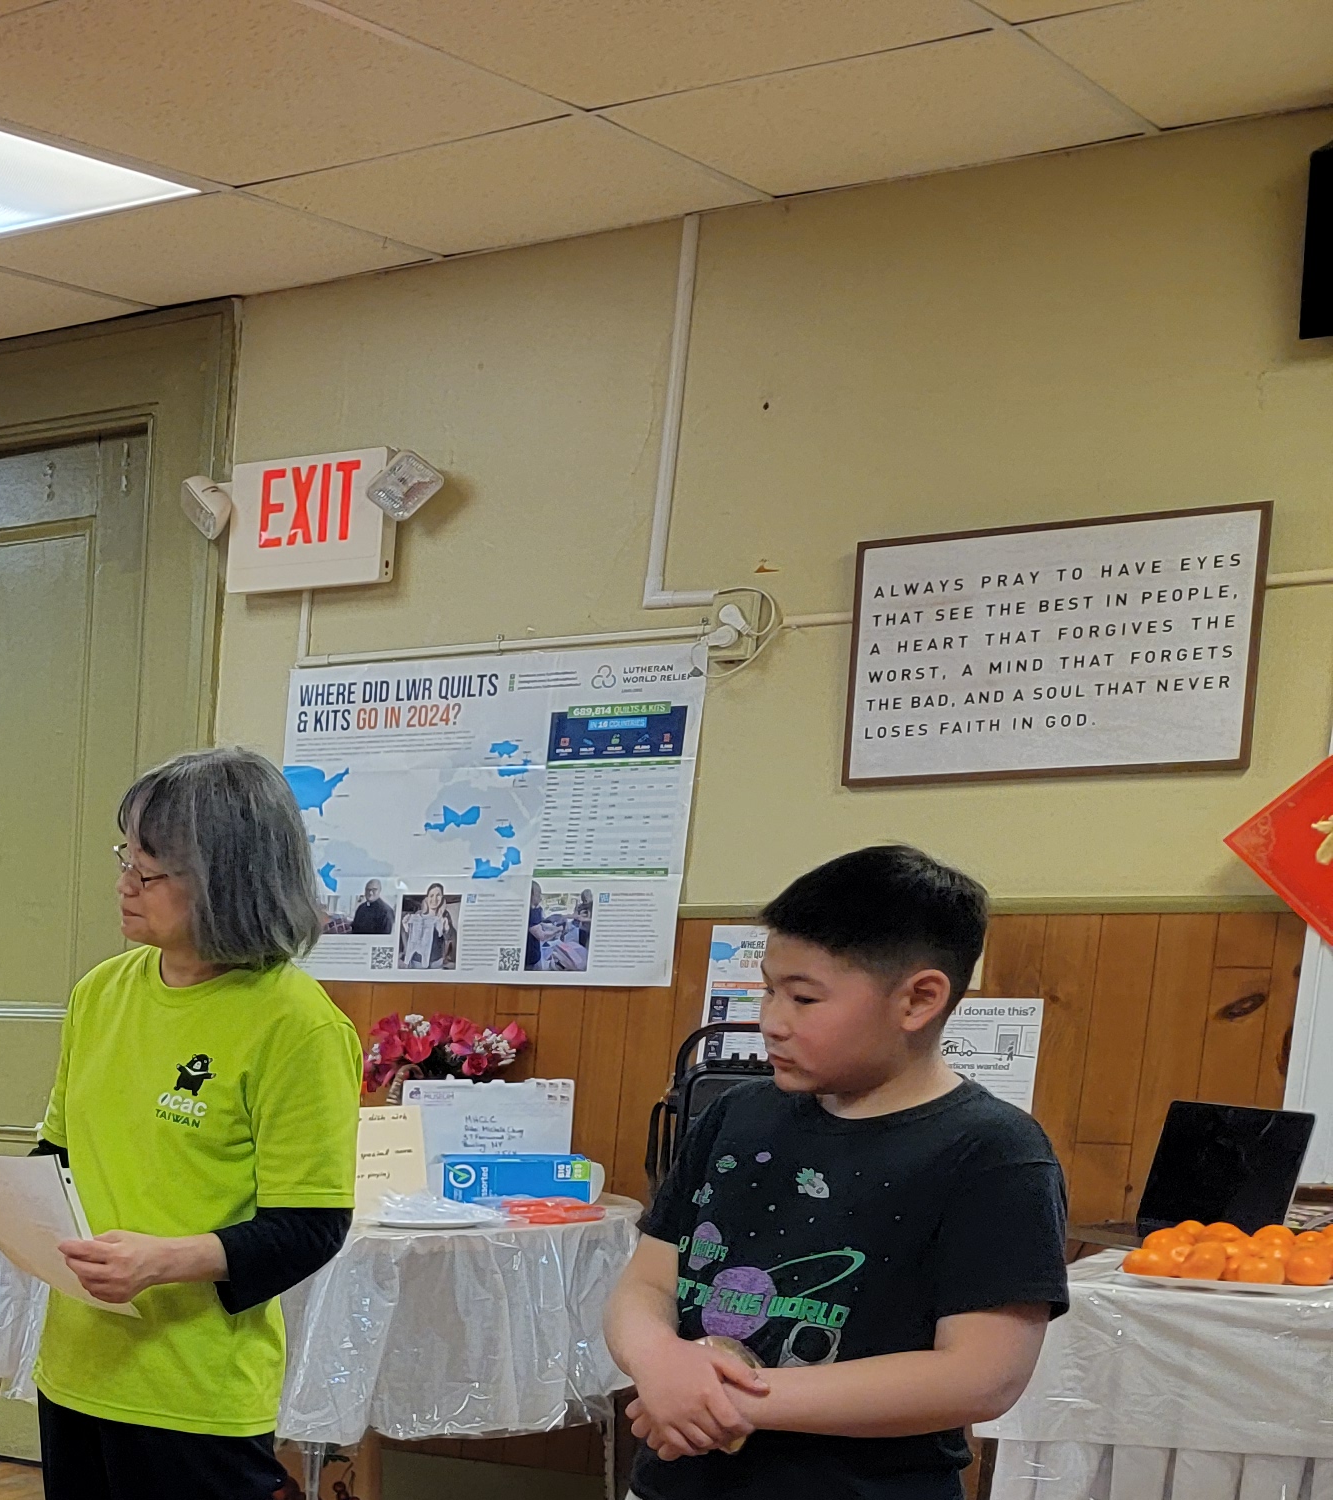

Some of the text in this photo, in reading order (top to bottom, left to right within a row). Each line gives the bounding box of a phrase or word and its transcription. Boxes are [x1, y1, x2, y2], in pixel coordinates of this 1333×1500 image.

[259, 460, 361, 548] EXIT
[873, 553, 1242, 599] ALWAYS PRAY TO HAVE EYES
[872, 584, 1239, 628] THAT SEE THE BEST IN PEOPLE,
[869, 614, 1237, 656] A HEART THAT FORGIVES THE
[623, 664, 674, 675] LUTHERAN
[868, 644, 1234, 684] WORST, A MIND THAT FORGETS
[299, 681, 358, 707] WHERE
[362, 679, 390, 704] DID
[395, 677, 433, 701] LWR
[438, 673, 499, 700] QUILTS
[622, 674, 657, 684] WORLD
[866, 675, 1231, 712] THE BAD, AND A SOUL THAT NEVER
[297, 702, 462, 733] & KITS GO IN 2024?
[613, 704, 640, 715] QUILTS
[641, 704, 647, 713] &
[648, 703, 666, 712] KITS
[609, 719, 645, 728] COUNTRIES
[864, 713, 1097, 740] LOSES FAITH IN GOD.
[741, 940, 765, 949] WHERE
[964, 1006, 1005, 1016] donate
[1008, 1006, 1036, 1016] this?
[977, 1063, 1010, 1071] wanted
[157, 1092, 208, 1117] ocac
[155, 1108, 200, 1129] TAIWAN
[717, 1288, 763, 1316] THIS
[766, 1295, 850, 1328] WORLD
